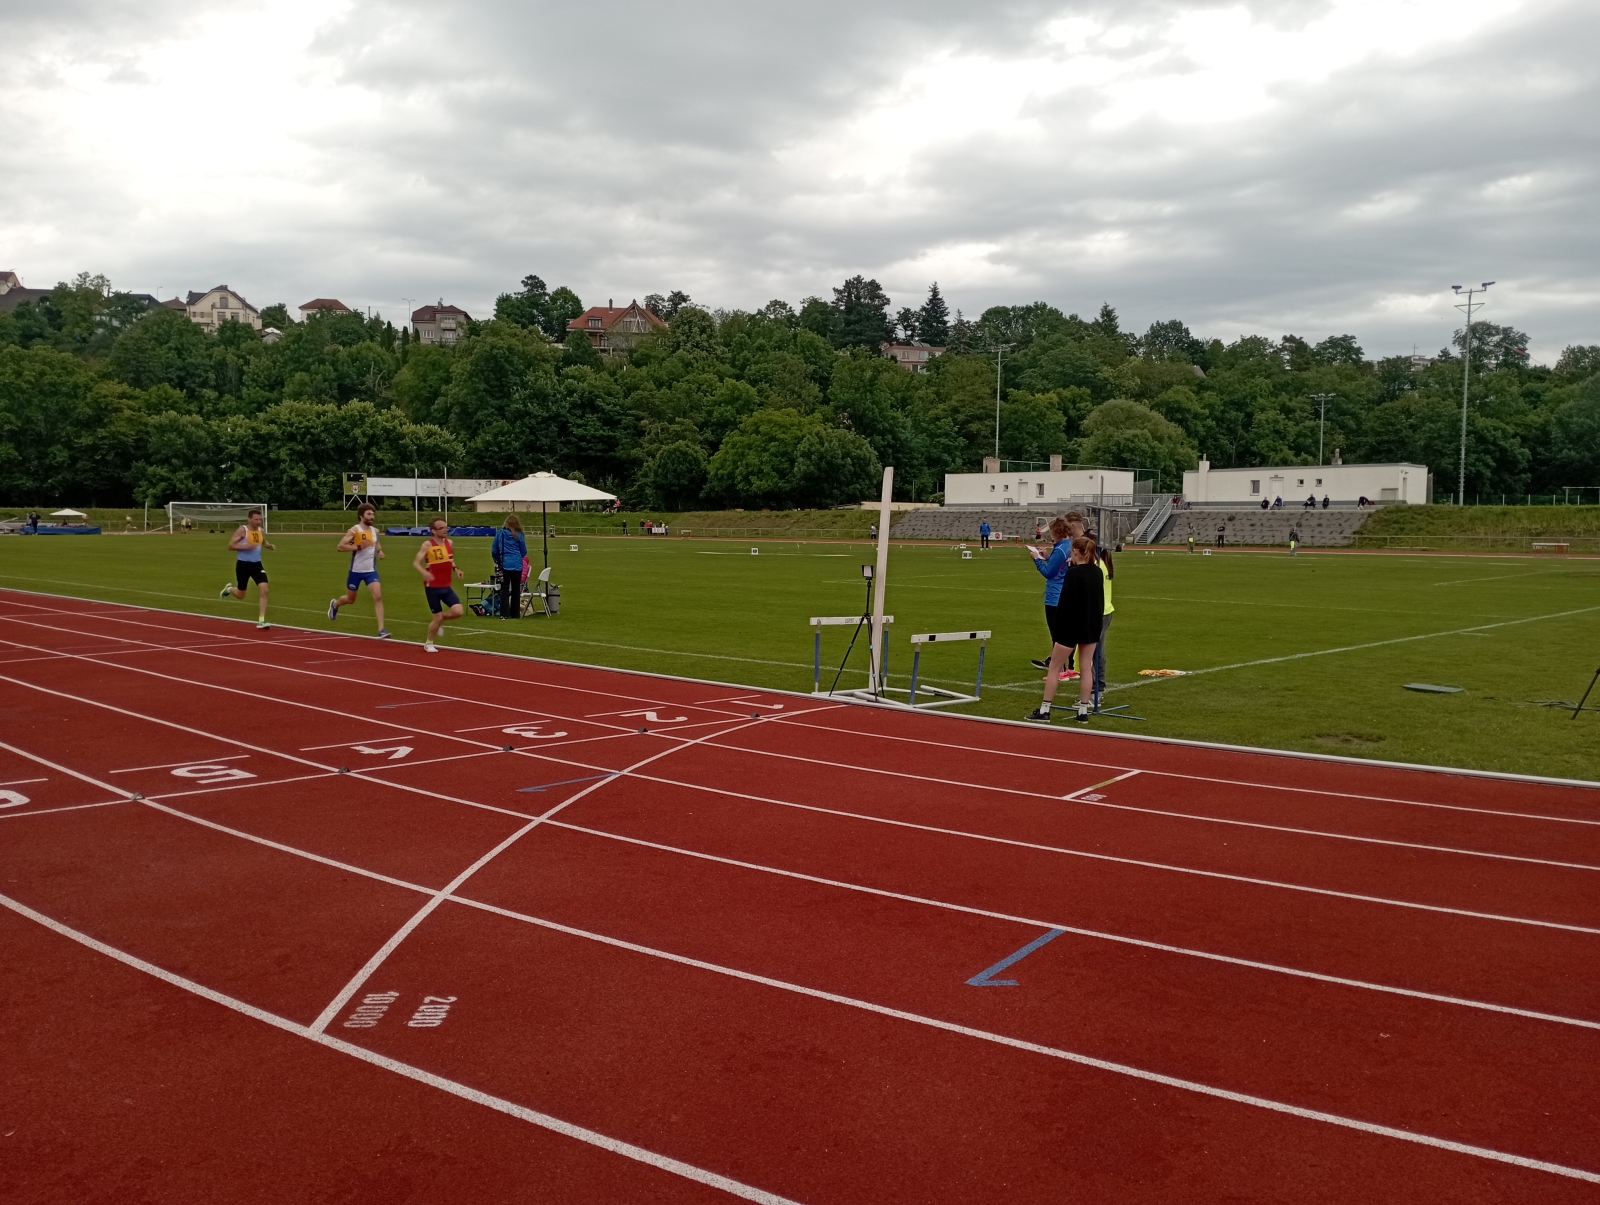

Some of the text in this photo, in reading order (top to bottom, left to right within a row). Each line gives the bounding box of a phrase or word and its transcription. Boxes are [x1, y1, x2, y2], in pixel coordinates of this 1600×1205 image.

[432, 548, 444, 560] 13
[731, 699, 784, 710] 1
[619, 711, 689, 723] 2
[502, 726, 568, 739] 3
[350, 745, 414, 760] 4
[171, 765, 258, 784] 5
[407, 996, 458, 1027] 2000
